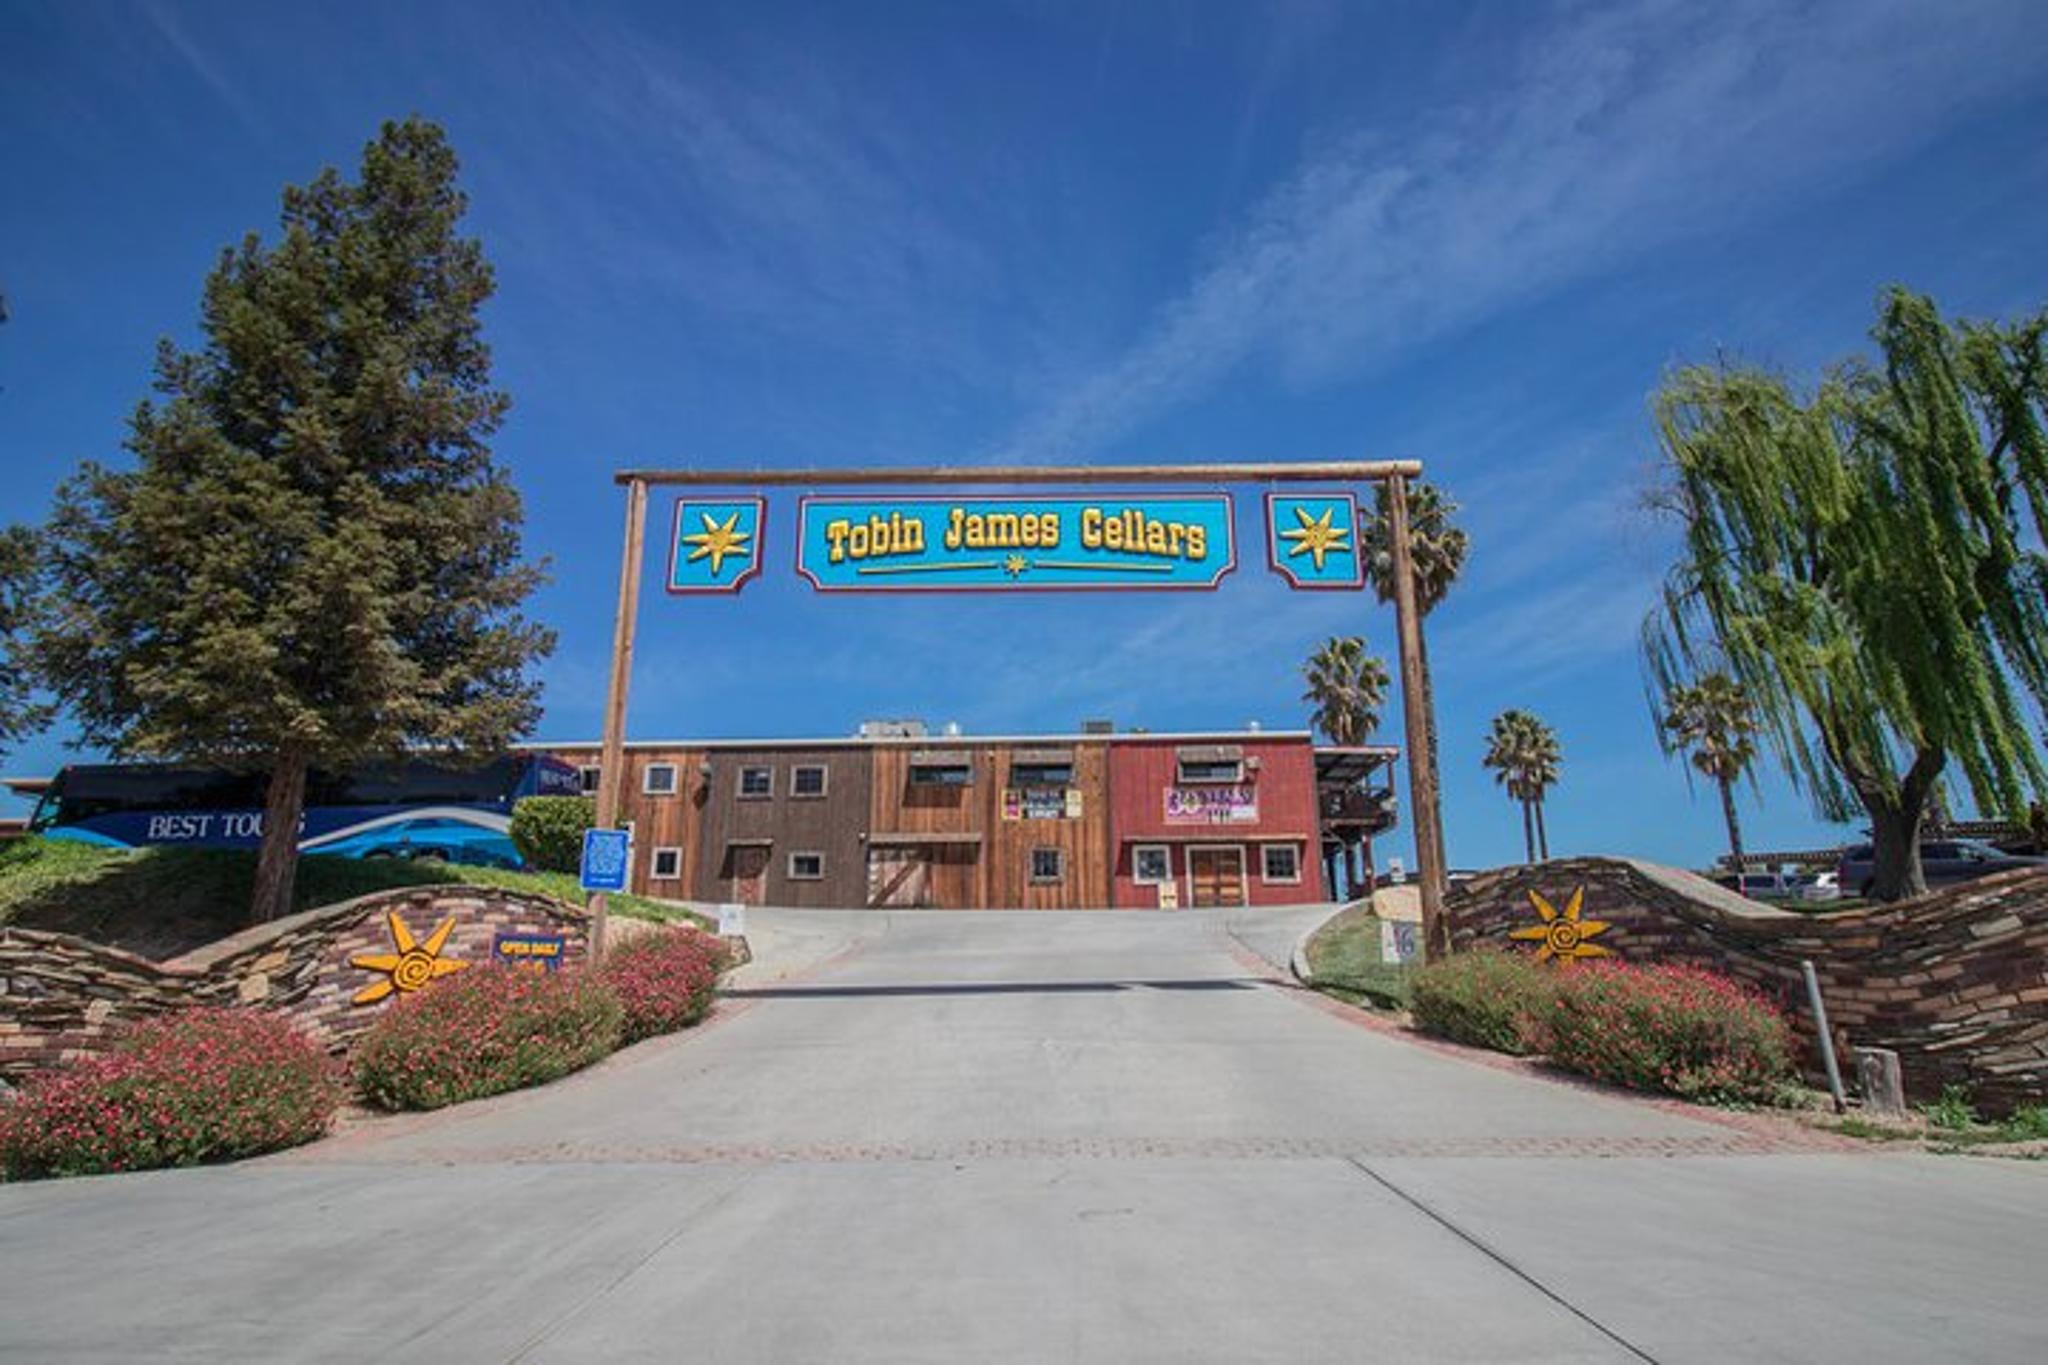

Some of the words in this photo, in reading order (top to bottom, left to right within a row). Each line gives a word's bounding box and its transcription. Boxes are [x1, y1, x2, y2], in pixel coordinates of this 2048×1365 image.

[827, 512, 924, 561] Tobin
[945, 507, 1060, 549] James
[1081, 507, 1207, 559] Cellars
[148, 814, 214, 839] BEST
[221, 812, 305, 838] TOU
